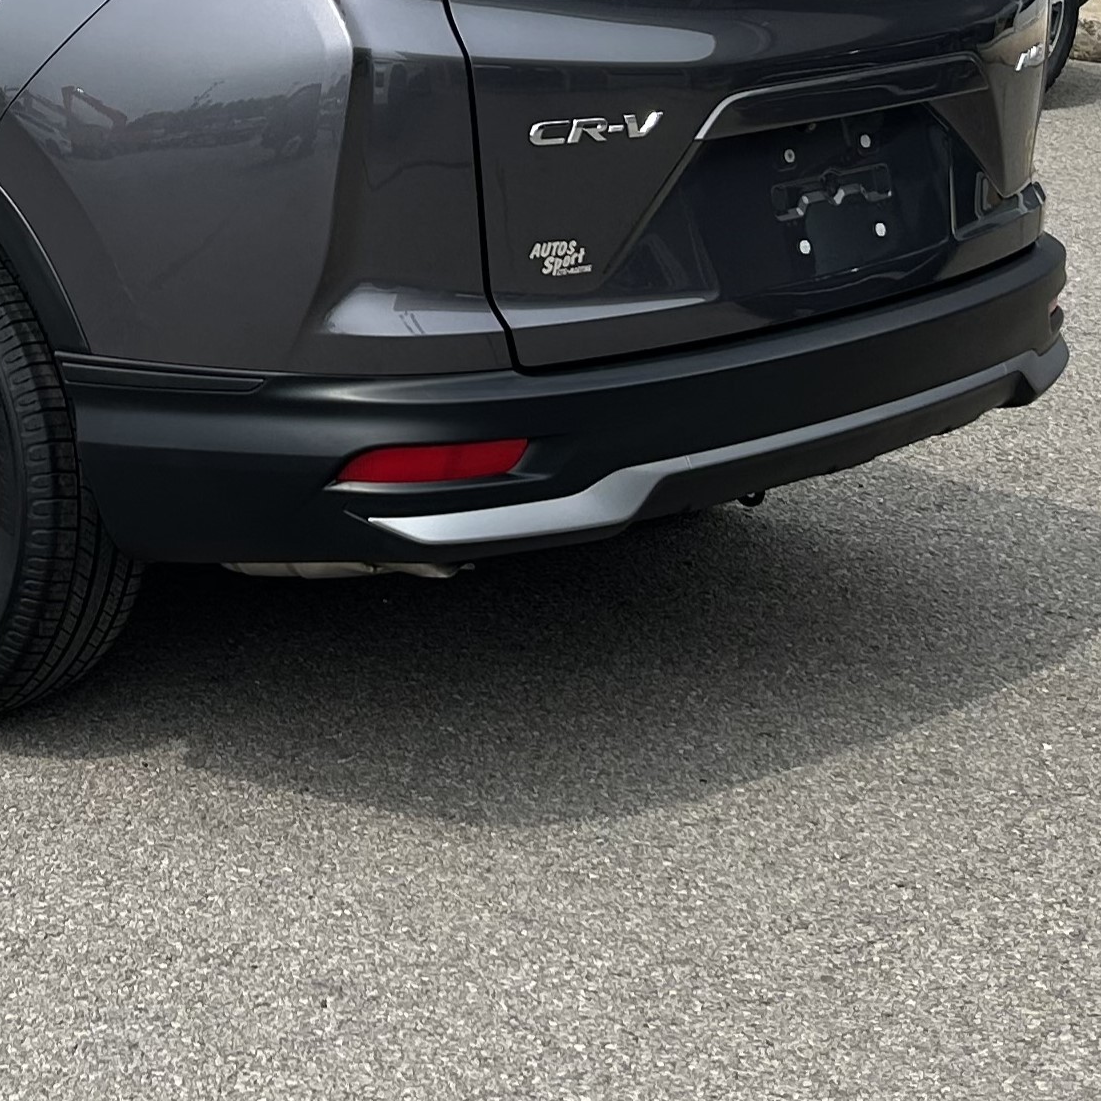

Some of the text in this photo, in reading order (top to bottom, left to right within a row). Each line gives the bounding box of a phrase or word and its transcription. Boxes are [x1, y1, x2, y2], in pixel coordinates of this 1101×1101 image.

[529, 111, 664, 146] CR-V
[529, 239, 577, 260] AUTOS
[542, 247, 586, 277] Sport
